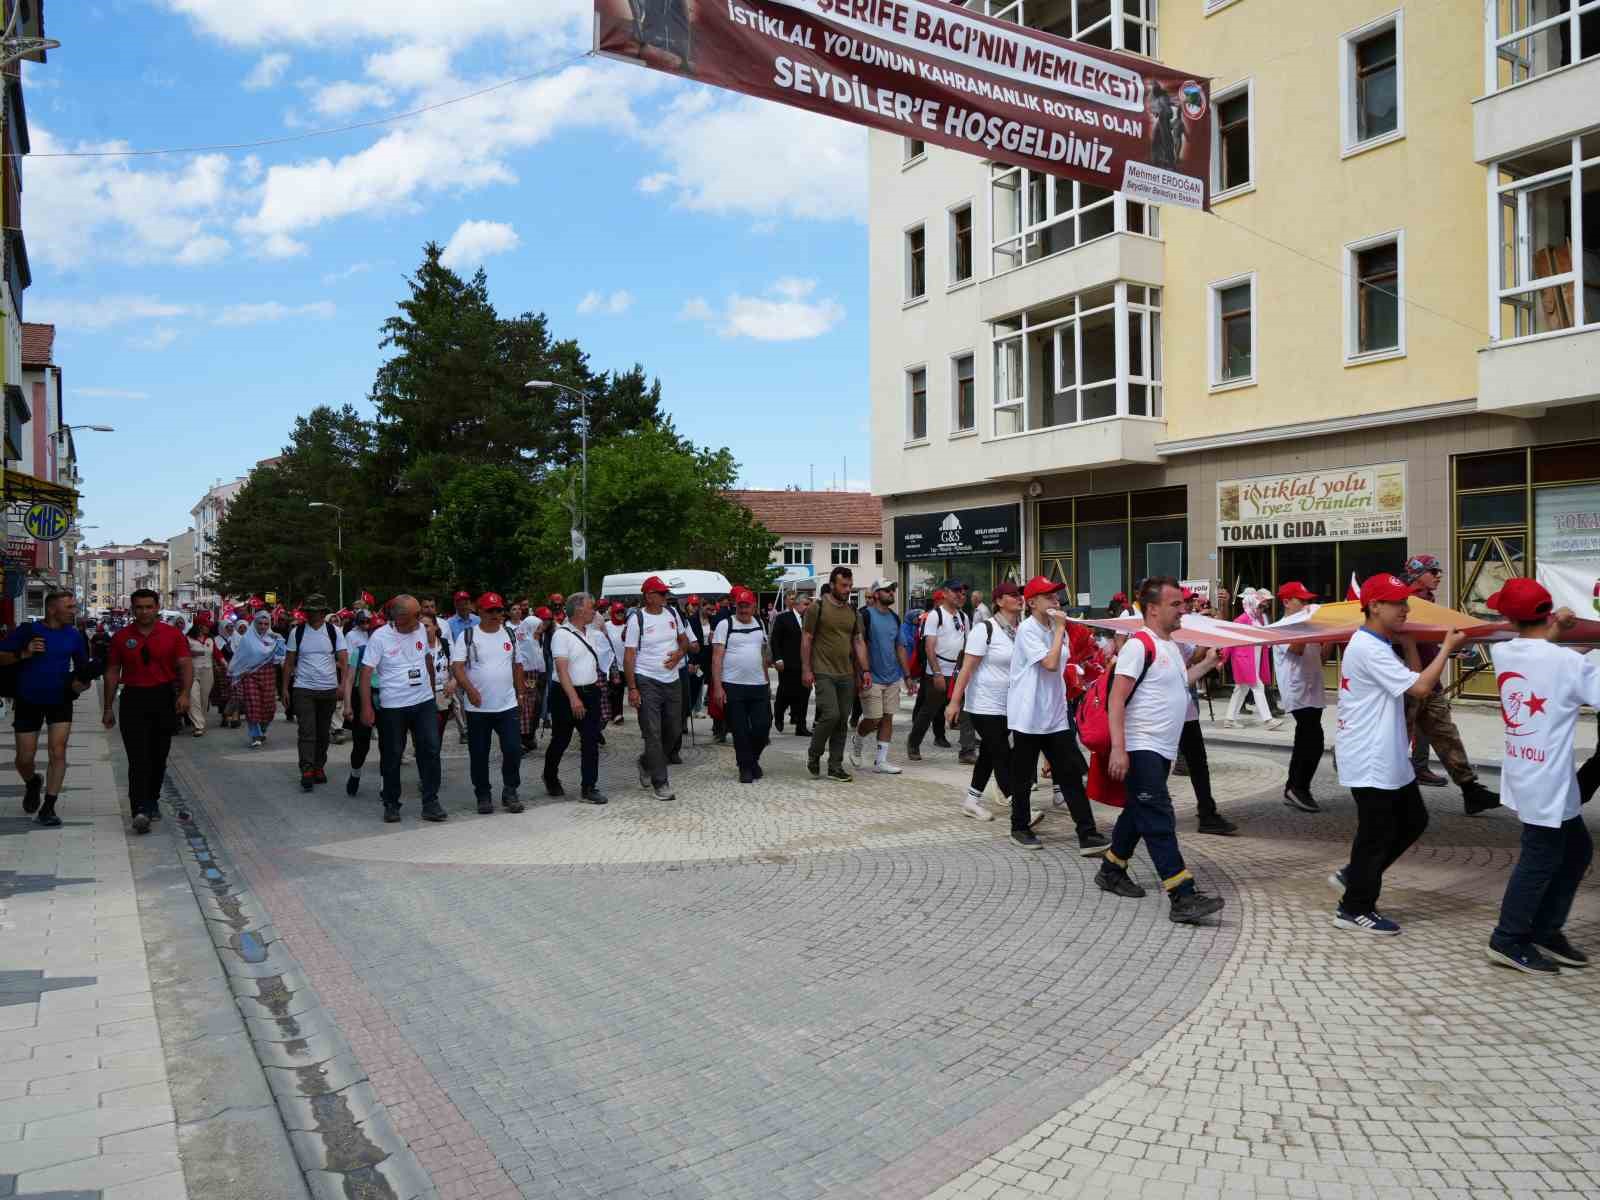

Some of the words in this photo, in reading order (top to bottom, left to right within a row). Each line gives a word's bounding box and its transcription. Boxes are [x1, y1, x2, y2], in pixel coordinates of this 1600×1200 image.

[728, 2, 816, 50] İSTİKLAL
[823, 31, 916, 75] YOLUNUN
[918, 61, 1040, 112] KAHRAMANLIK
[1042, 98, 1099, 128] ROTASI
[1102, 113, 1143, 139] OLAN
[1023, 45, 1141, 106] MEMLEKETİ
[773, 56, 941, 131] SEYDİLER'E
[944, 106, 1113, 174] HOŞGELDİNİZ
[1128, 165, 1160, 182] Mehmet
[1161, 174, 1201, 193] ERDOĞAN
[1322, 472, 1368, 498] yolu
[941, 529, 960, 543] G&S
[1221, 521, 1279, 542] TOKALI
[1283, 519, 1327, 538] GIDA
[1520, 745, 1545, 762] YOLU
